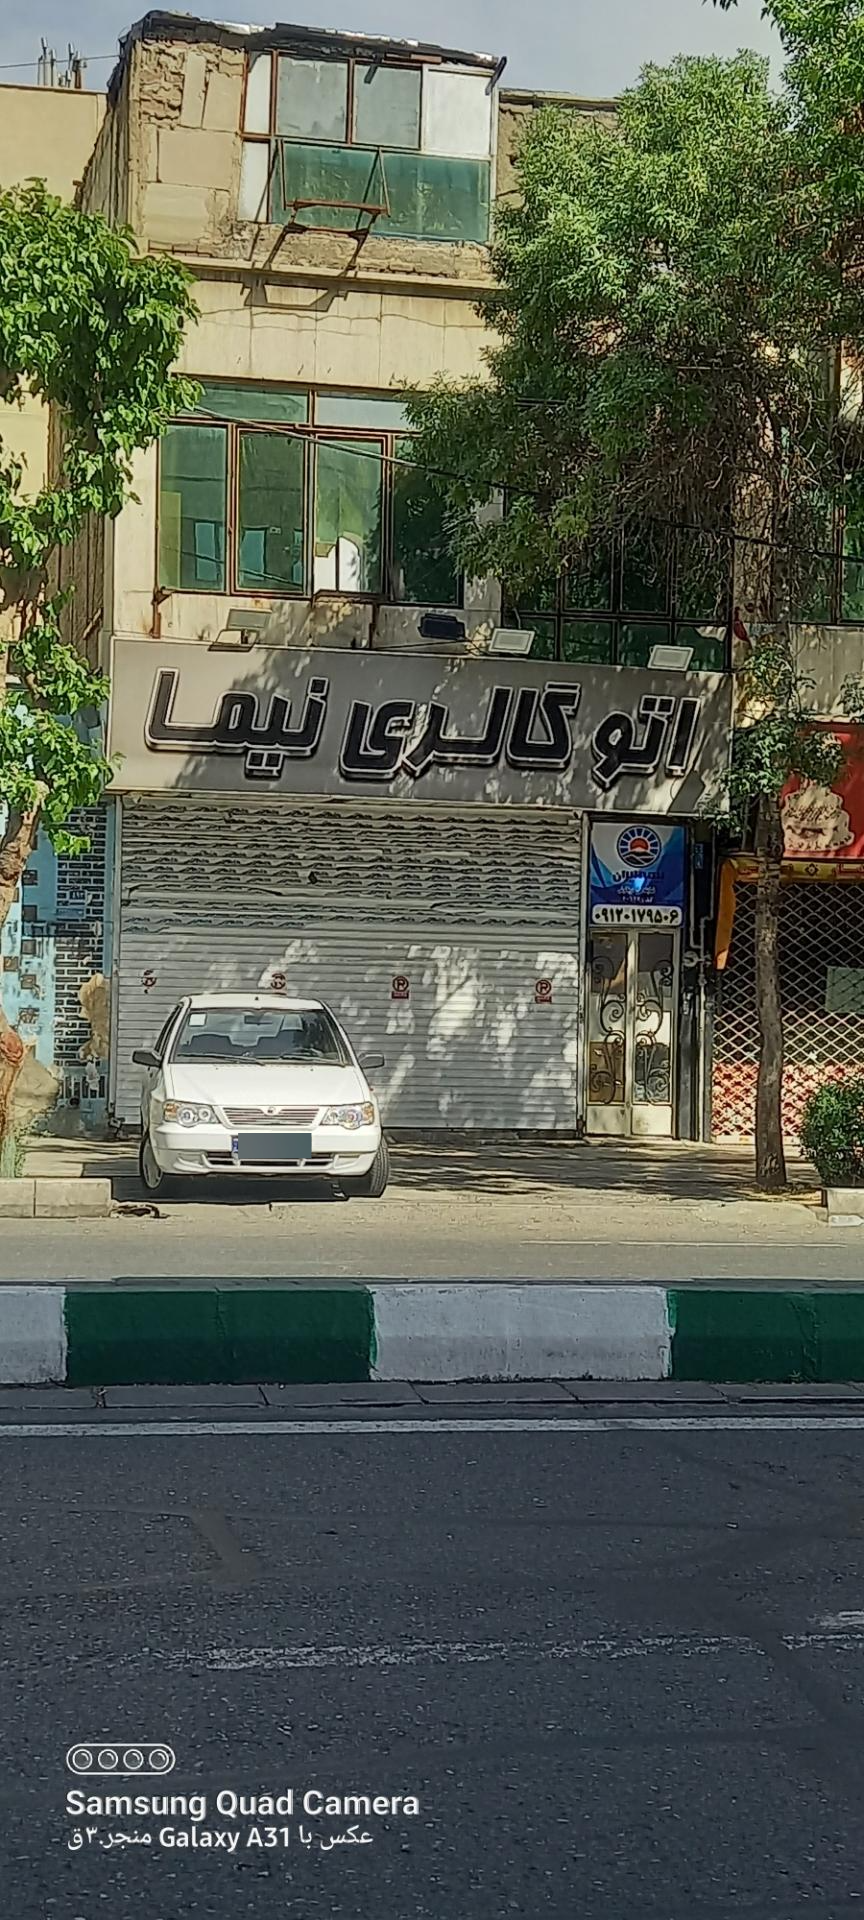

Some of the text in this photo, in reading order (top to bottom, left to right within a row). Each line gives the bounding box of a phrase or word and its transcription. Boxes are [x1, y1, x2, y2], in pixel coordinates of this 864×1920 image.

[145, 667, 700, 788] اتو گالری نیما
[594, 907, 679, 923] ۰۹۱۲۰۱۷۹۵۰۶
